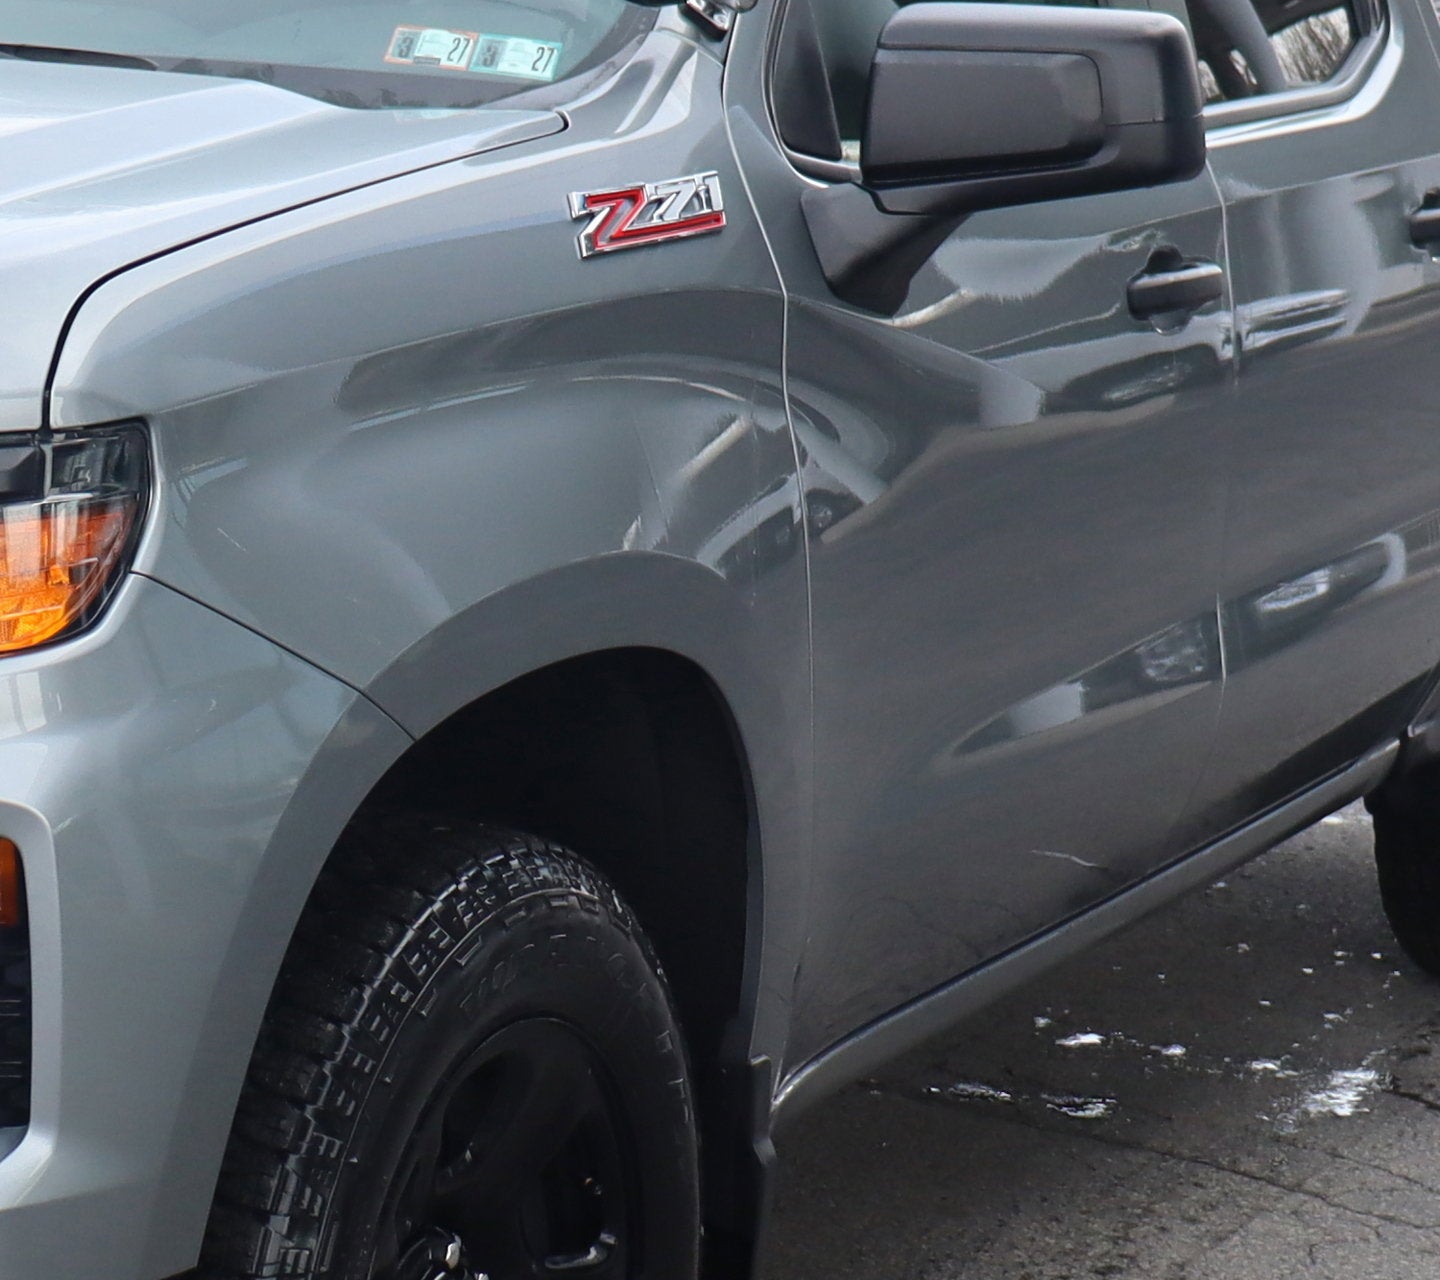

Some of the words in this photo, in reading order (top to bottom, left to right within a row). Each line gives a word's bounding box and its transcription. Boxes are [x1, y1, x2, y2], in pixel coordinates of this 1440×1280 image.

[446, 37, 470, 64] 27
[531, 46, 555, 74] 27
[567, 170, 727, 261] Z71
